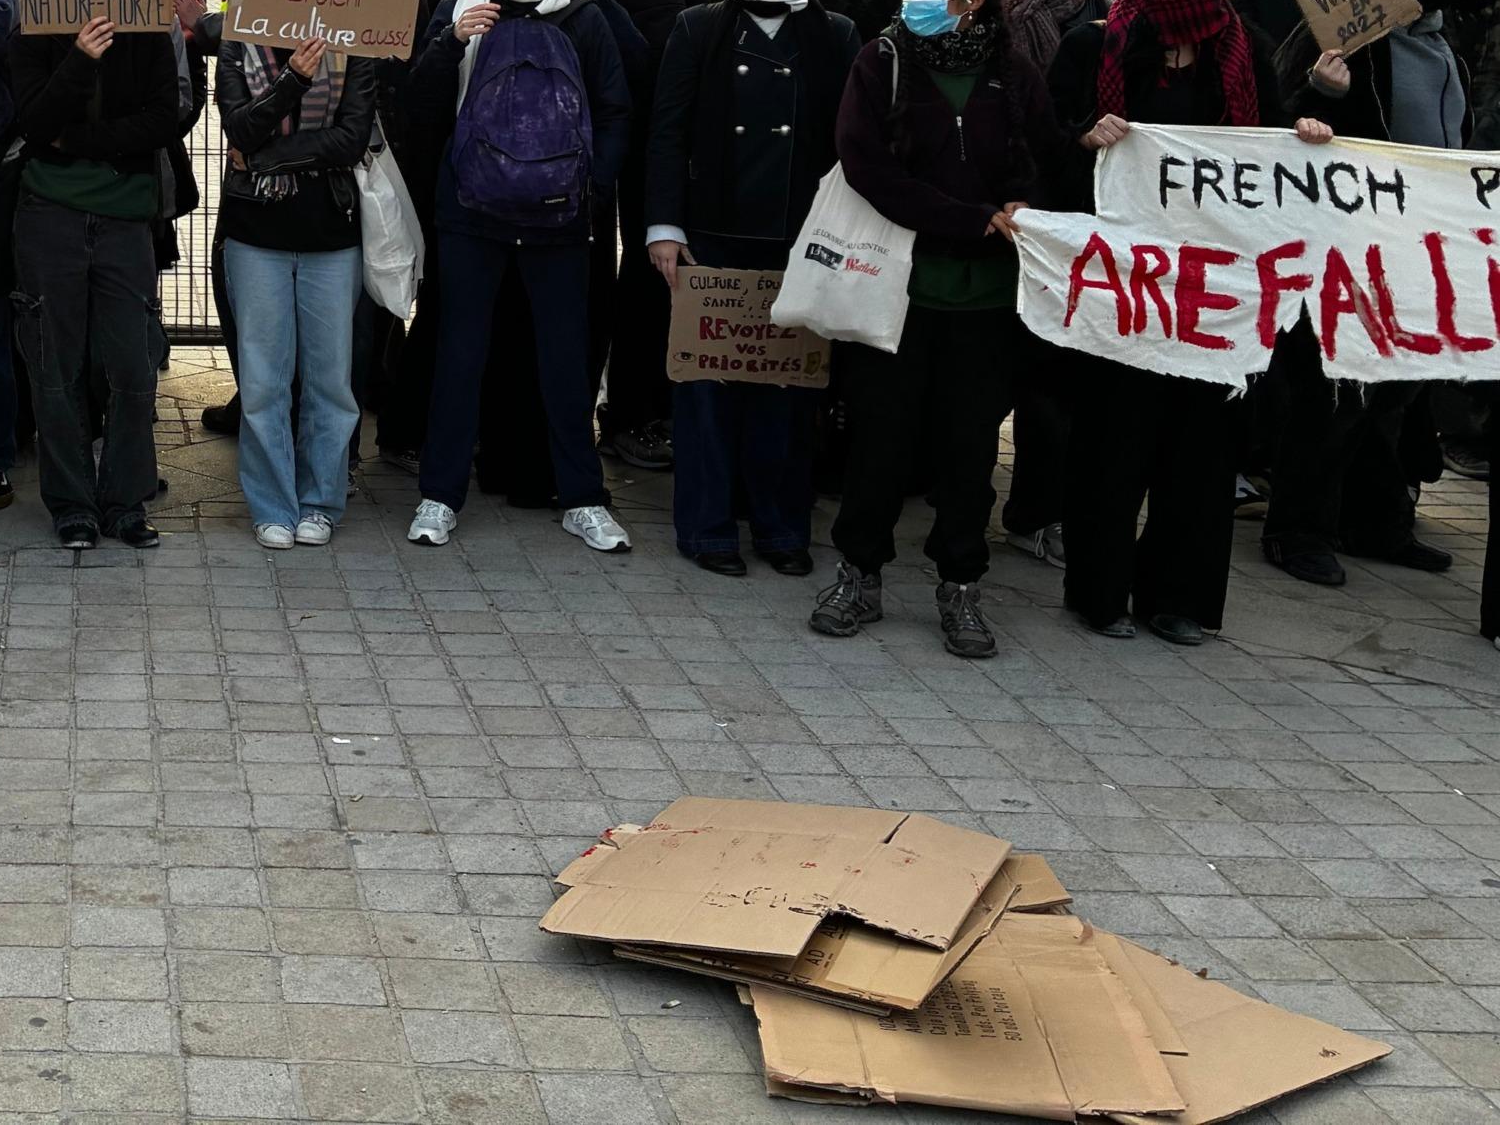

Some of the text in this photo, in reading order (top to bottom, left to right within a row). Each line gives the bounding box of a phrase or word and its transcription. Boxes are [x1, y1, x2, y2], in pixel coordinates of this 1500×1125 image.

[233, 6, 412, 48] La culture aussi
[1337, 4, 1387, 46] 2027
[1158, 155, 1410, 215] FRENCH
[700, 316, 797, 340] REVOYEZ
[735, 343, 766, 356] VOS
